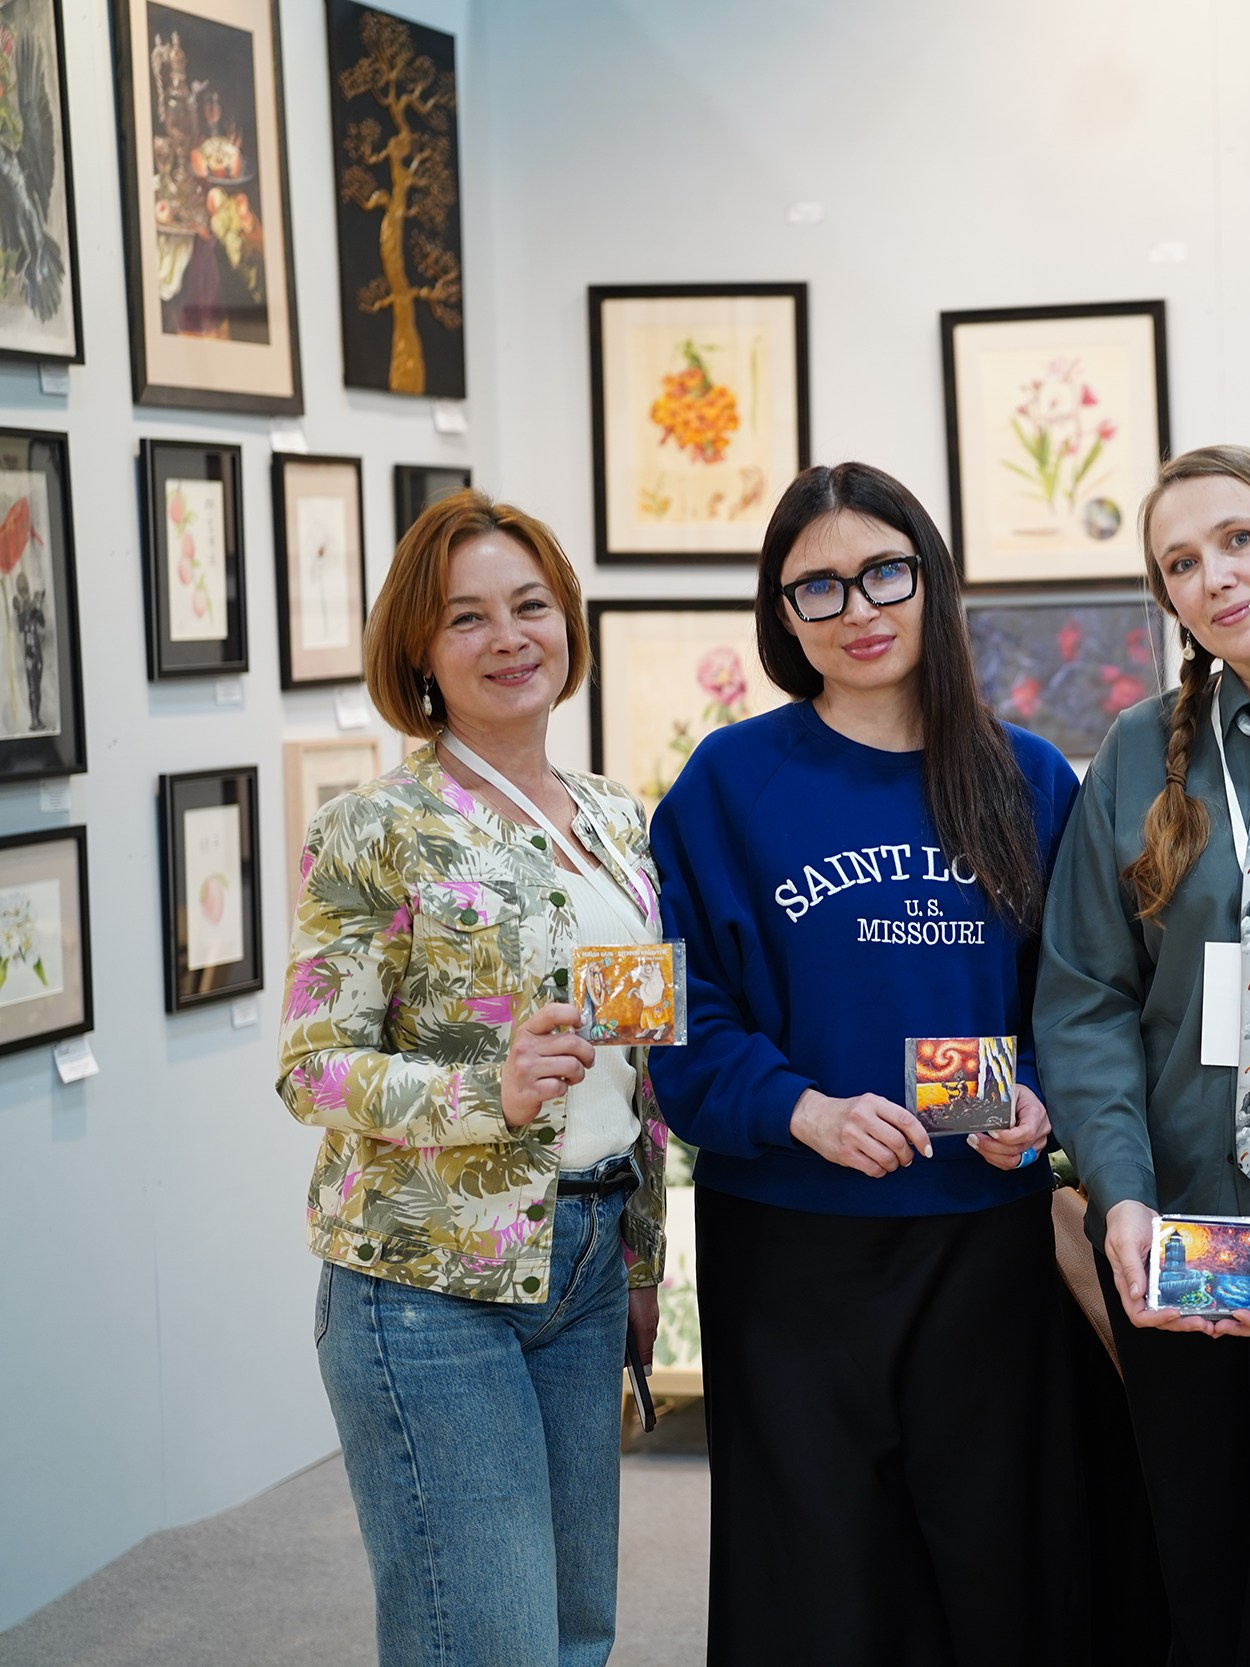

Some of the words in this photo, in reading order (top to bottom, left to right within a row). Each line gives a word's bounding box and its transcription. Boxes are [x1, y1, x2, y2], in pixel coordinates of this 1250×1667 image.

[775, 844, 911, 923] SAINT
[904, 899, 923, 917] U.
[927, 898, 944, 917] S.
[857, 918, 985, 945] MISSOURI
